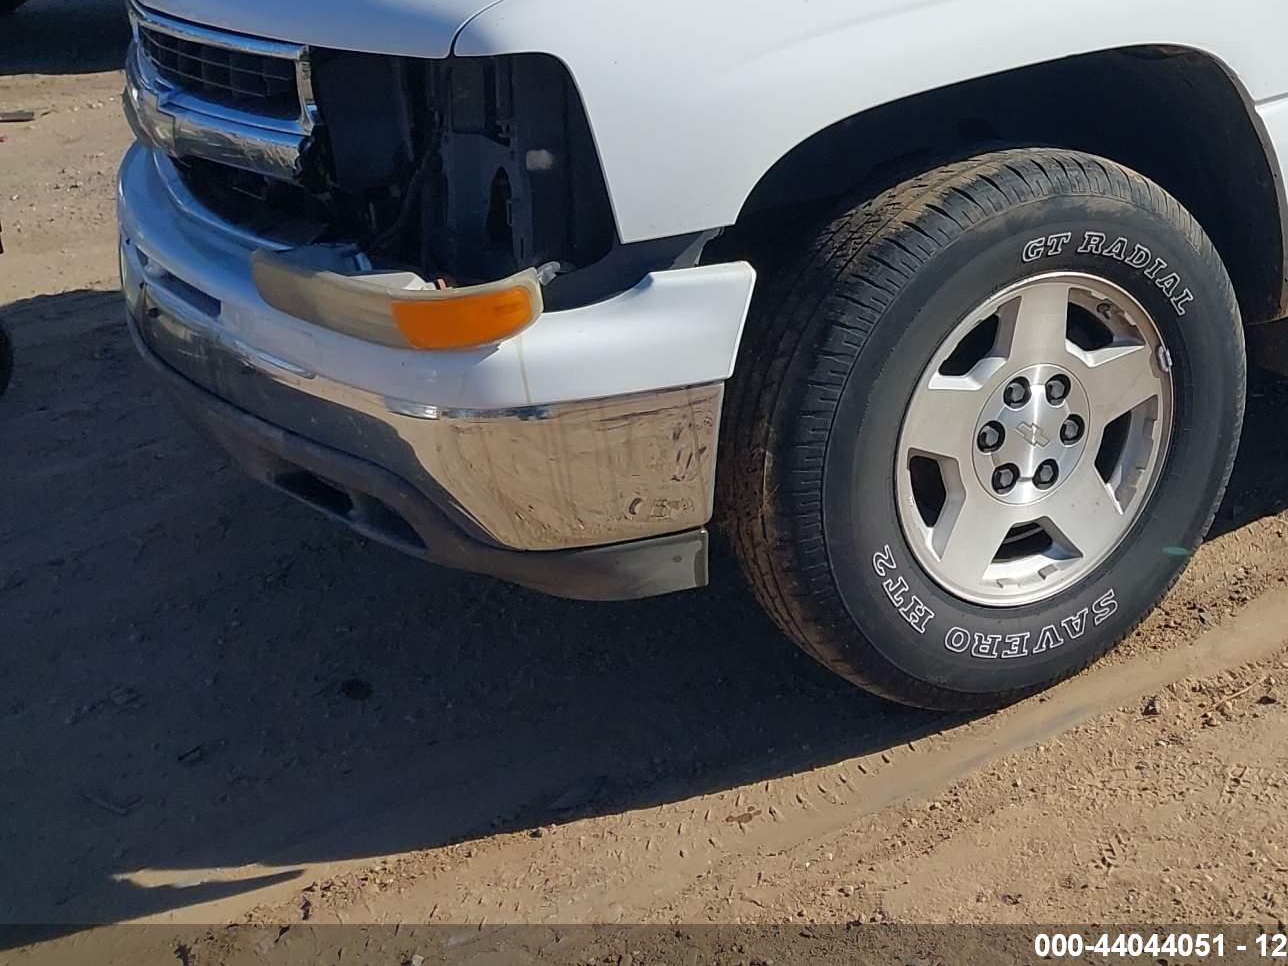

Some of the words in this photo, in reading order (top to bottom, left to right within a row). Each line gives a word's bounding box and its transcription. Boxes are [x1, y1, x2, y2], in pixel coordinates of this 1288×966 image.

[1022, 231, 1072, 263] GT
[1077, 231, 1194, 316] RADIAL
[872, 544, 936, 634] HT2
[944, 588, 1119, 659] SAVERO
